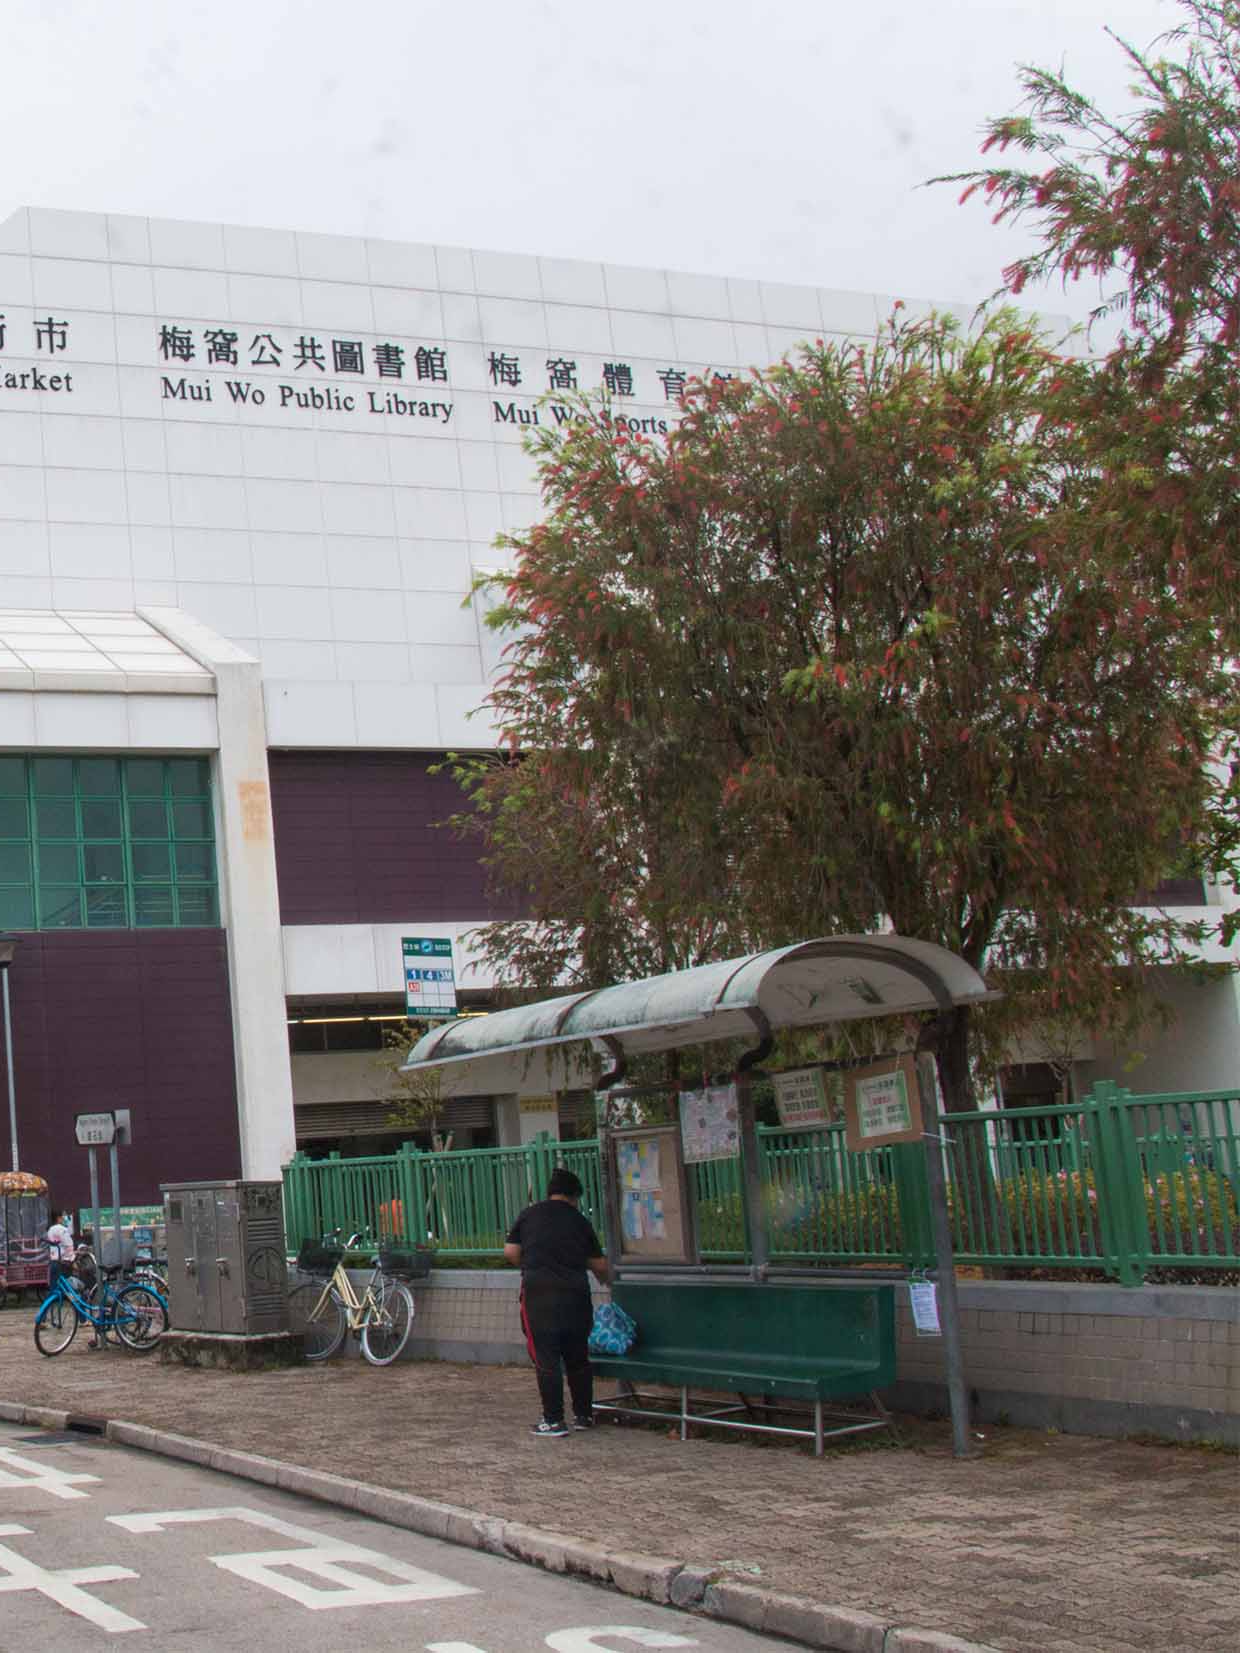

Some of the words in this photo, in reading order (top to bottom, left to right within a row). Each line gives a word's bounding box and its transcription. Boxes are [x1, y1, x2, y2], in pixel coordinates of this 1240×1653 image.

[158, 324, 449, 383] 梅窩公共圖書館
[488, 351, 735, 401] 梅窩體育
[160, 376, 213, 402] Mui
[224, 380, 265, 405] Wo
[278, 385, 355, 411] Public
[367, 391, 455, 424] Library
[492, 400, 540, 426] Mui
[425, 969, 434, 981] 4
